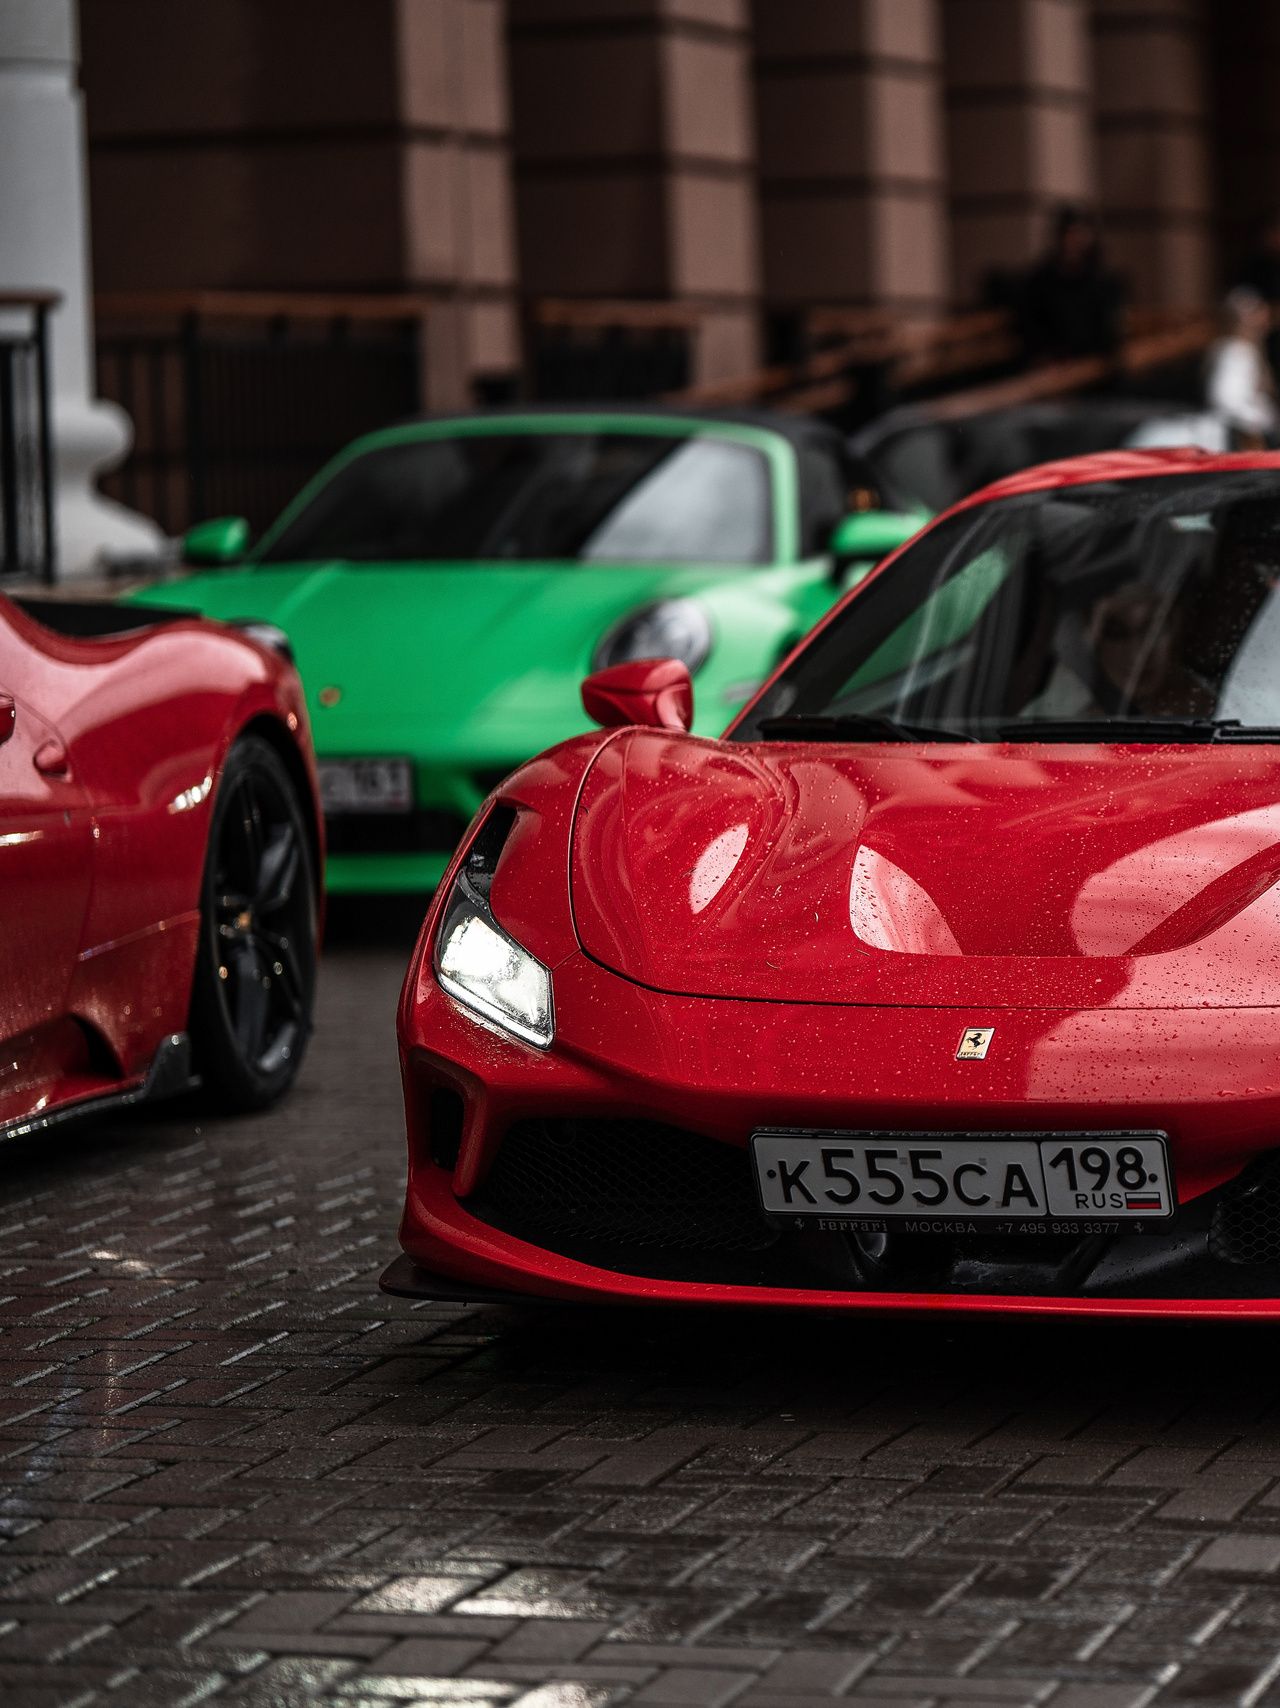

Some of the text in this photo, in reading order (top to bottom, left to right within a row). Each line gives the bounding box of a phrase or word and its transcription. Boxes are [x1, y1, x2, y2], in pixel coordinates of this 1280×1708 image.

[1050, 1146, 1147, 1191] 198
[1075, 1193, 1123, 1209] RUS
[817, 1218, 888, 1232] Ferrari
[995, 1222, 1120, 1234] +7 495 933 3377
